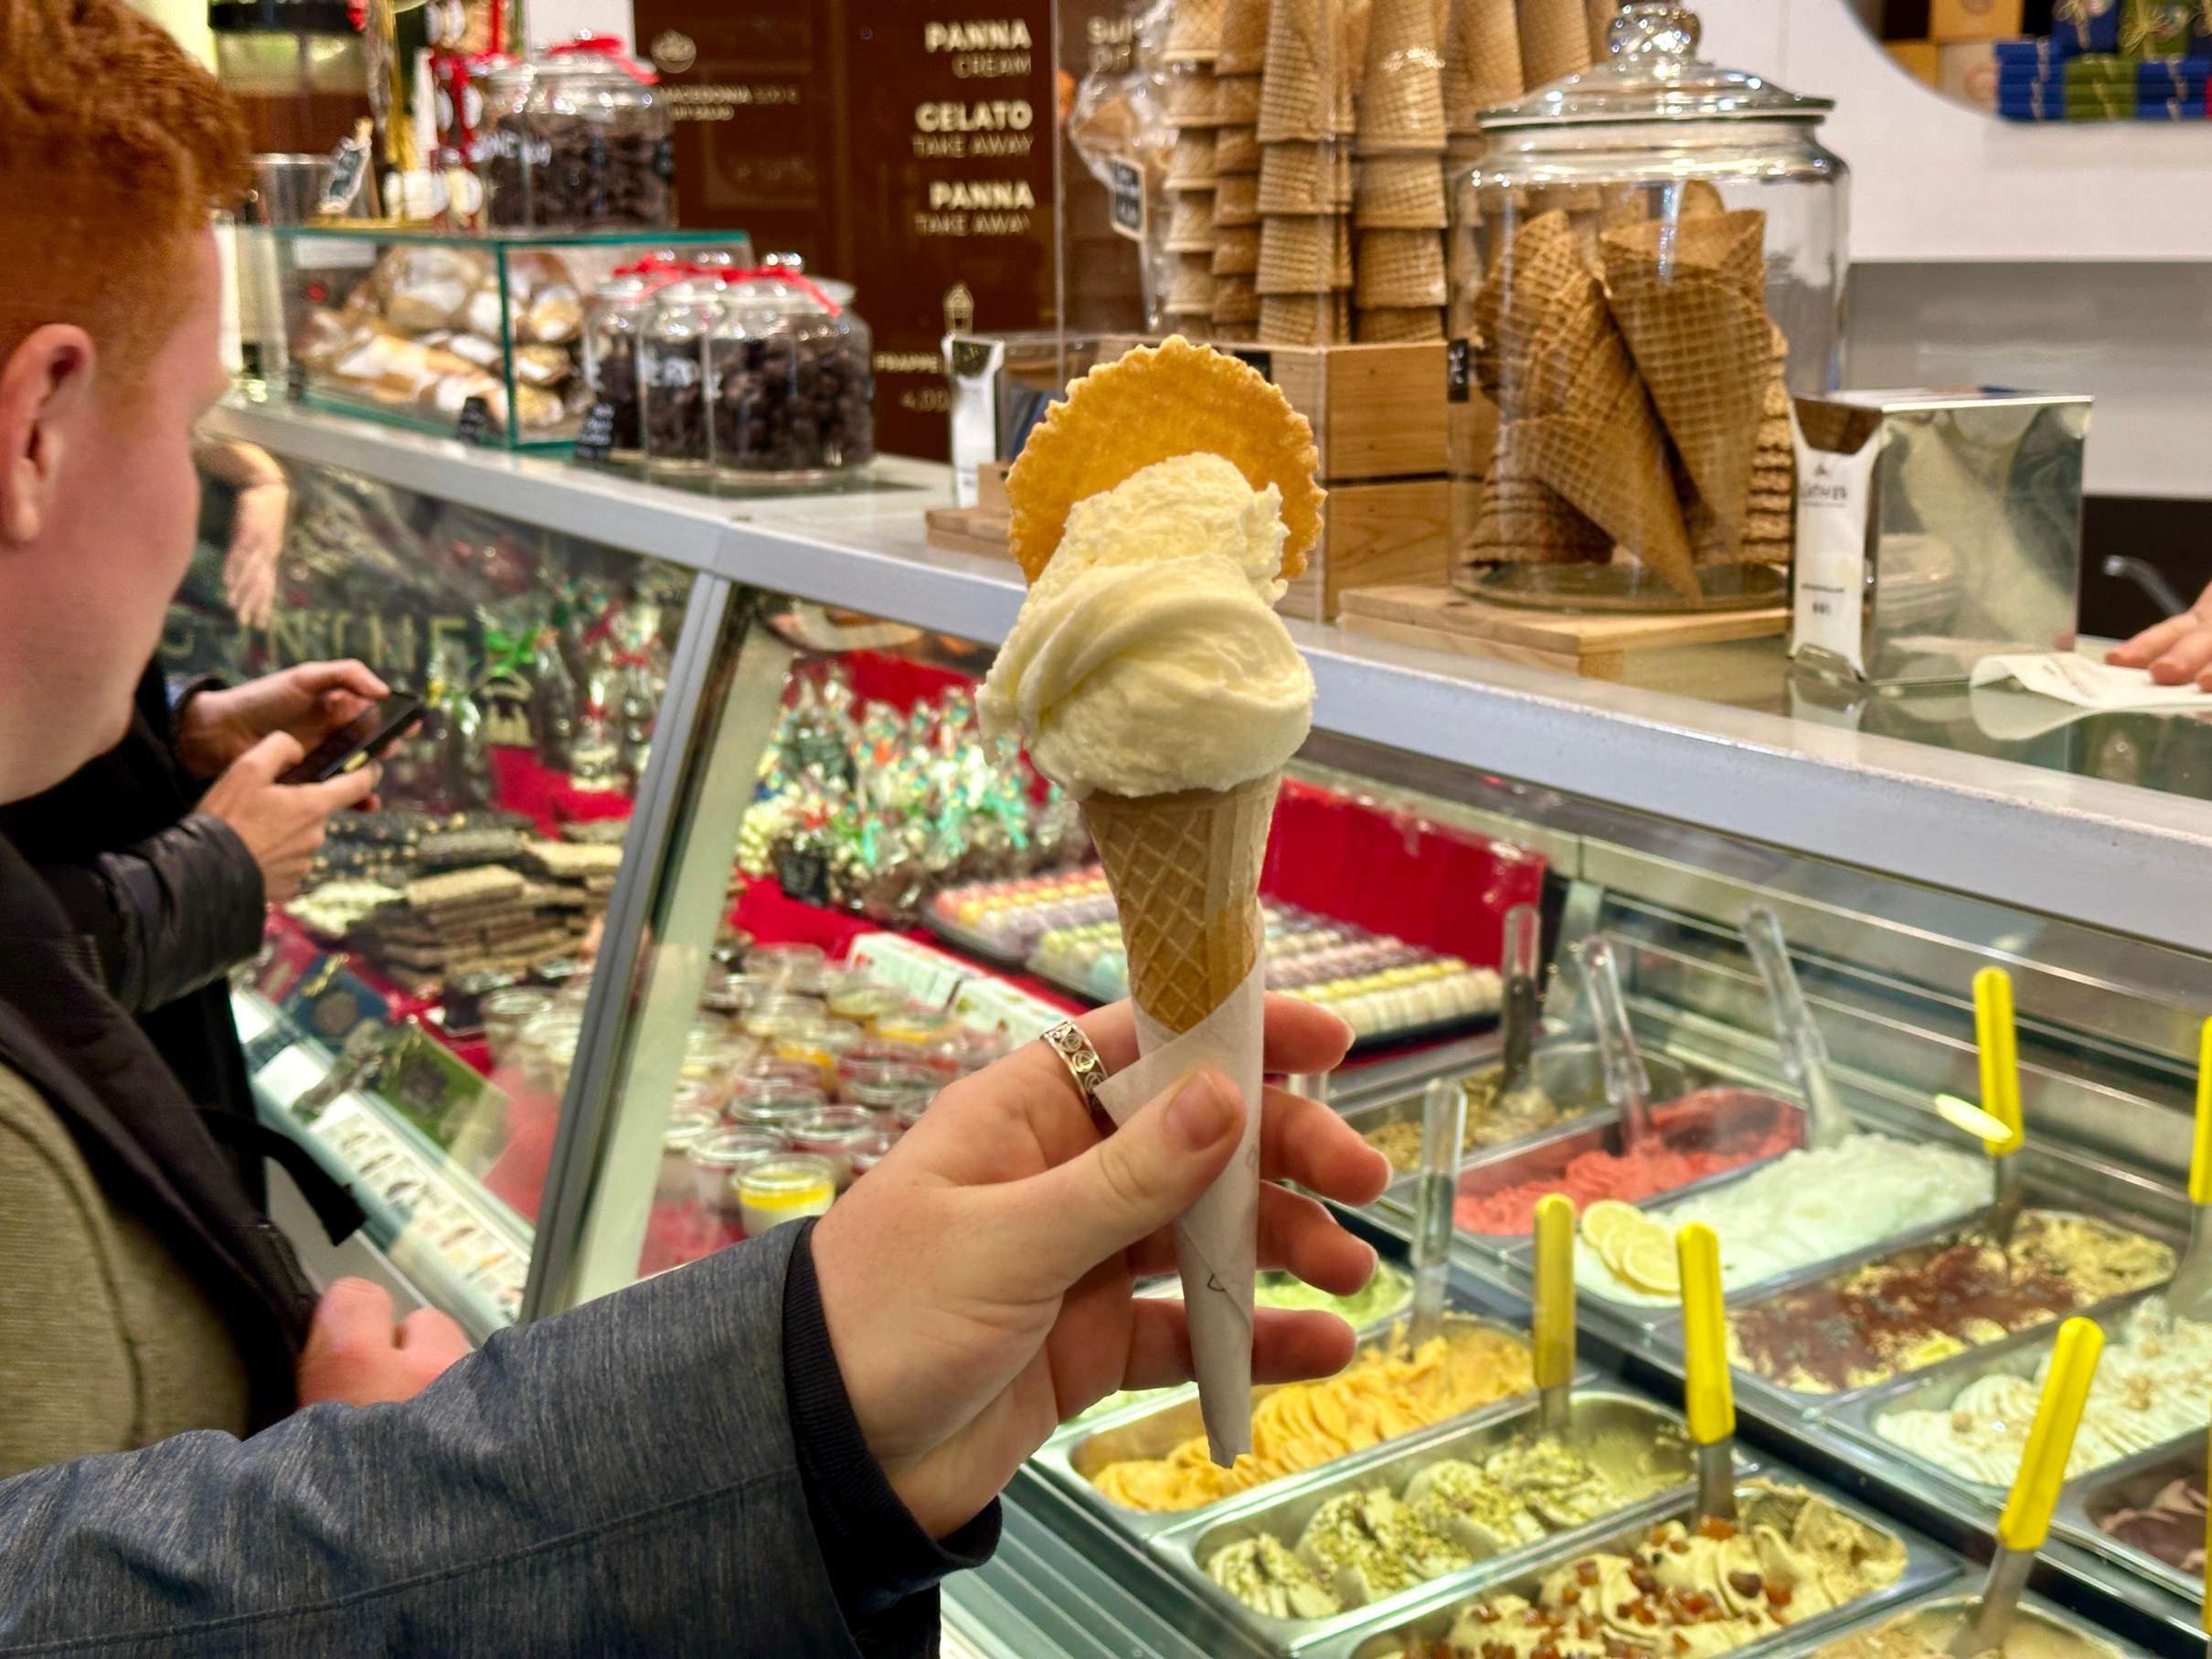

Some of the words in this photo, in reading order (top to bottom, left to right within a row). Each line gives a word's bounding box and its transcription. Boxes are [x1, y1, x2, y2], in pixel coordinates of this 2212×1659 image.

[924, 18, 1033, 52] PANNA
[952, 50, 1031, 79] CREAM
[915, 100, 1034, 133] GELATO
[912, 133, 967, 158] TAKE
[970, 132, 1035, 156] AWAY
[929, 181, 1036, 211] PANNA
[915, 211, 967, 237] TAKE
[972, 210, 1031, 236] AWAY
